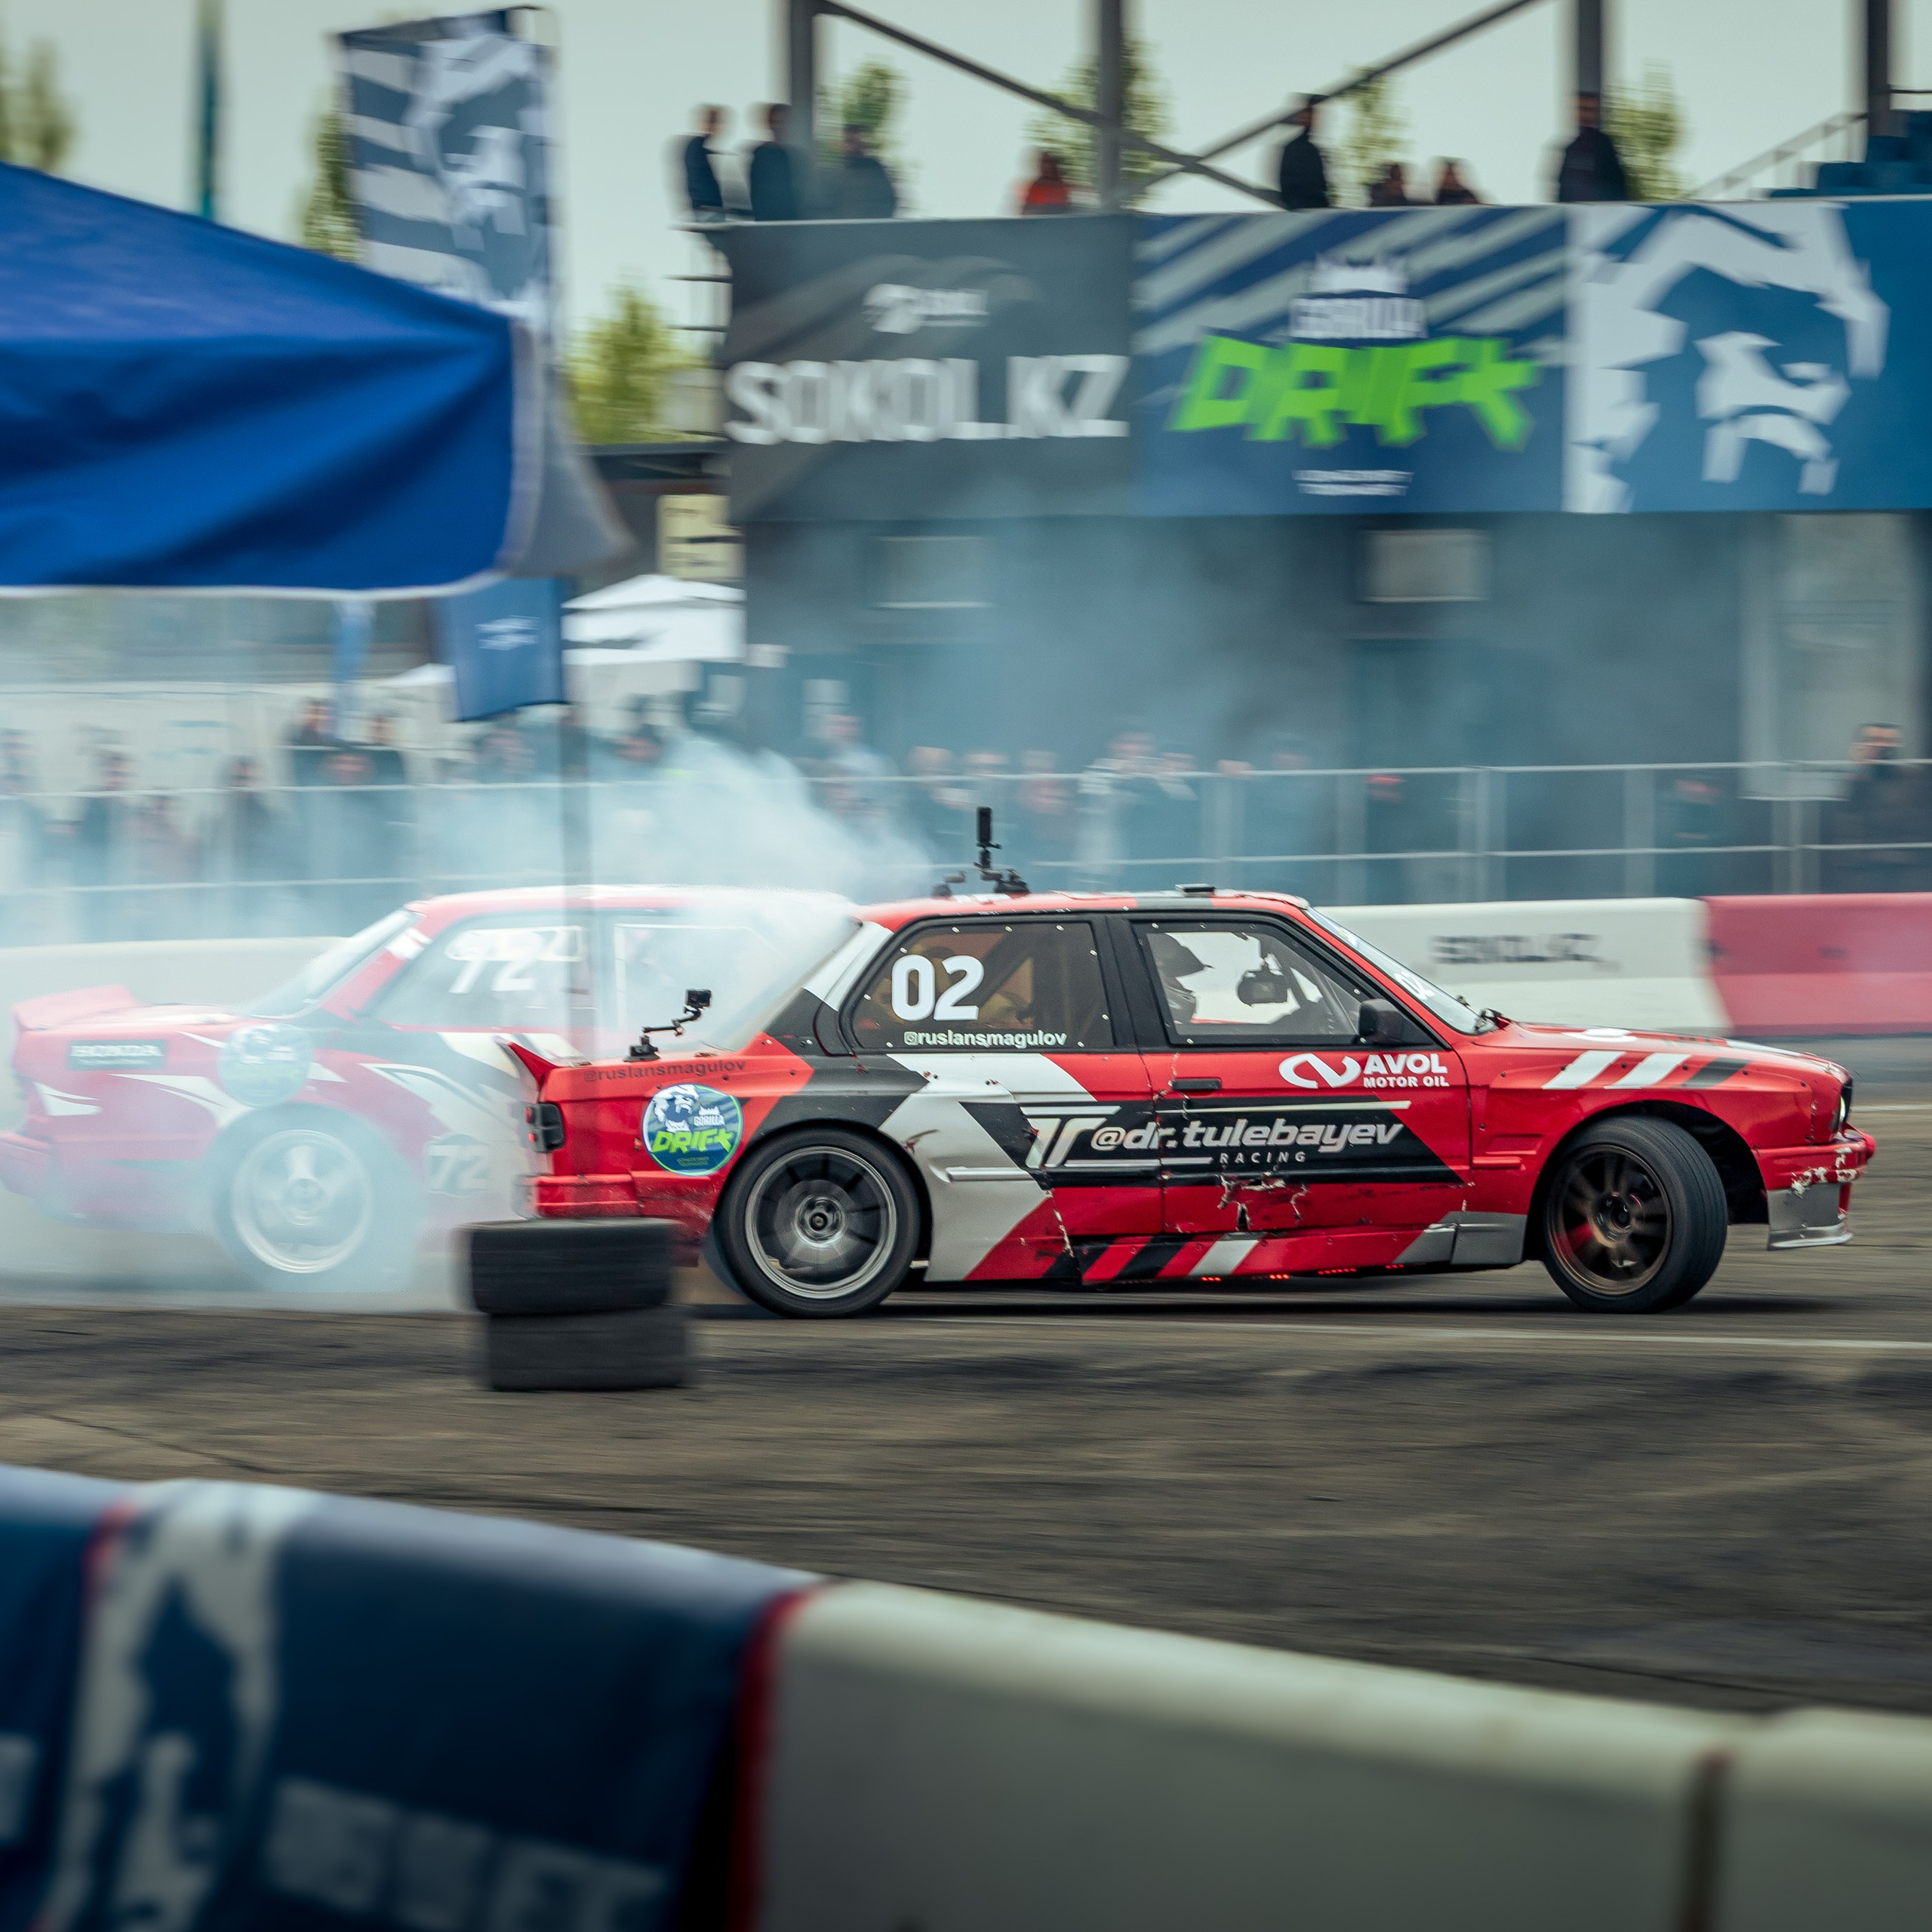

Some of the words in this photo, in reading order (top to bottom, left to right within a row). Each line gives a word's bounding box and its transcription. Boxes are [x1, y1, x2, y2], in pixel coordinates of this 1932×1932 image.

[891, 954, 985, 1021] 02
[1363, 1054, 1448, 1075] AVOL
[1363, 1076, 1418, 1088] MOTOR
[1423, 1075, 1450, 1088] OIL
[694, 1114, 725, 1127] GORILLA
[651, 1128, 735, 1154] DRIFT
[1091, 1118, 1404, 1153] @dr.tulebayev
[1219, 1151, 1306, 1164] RACING
